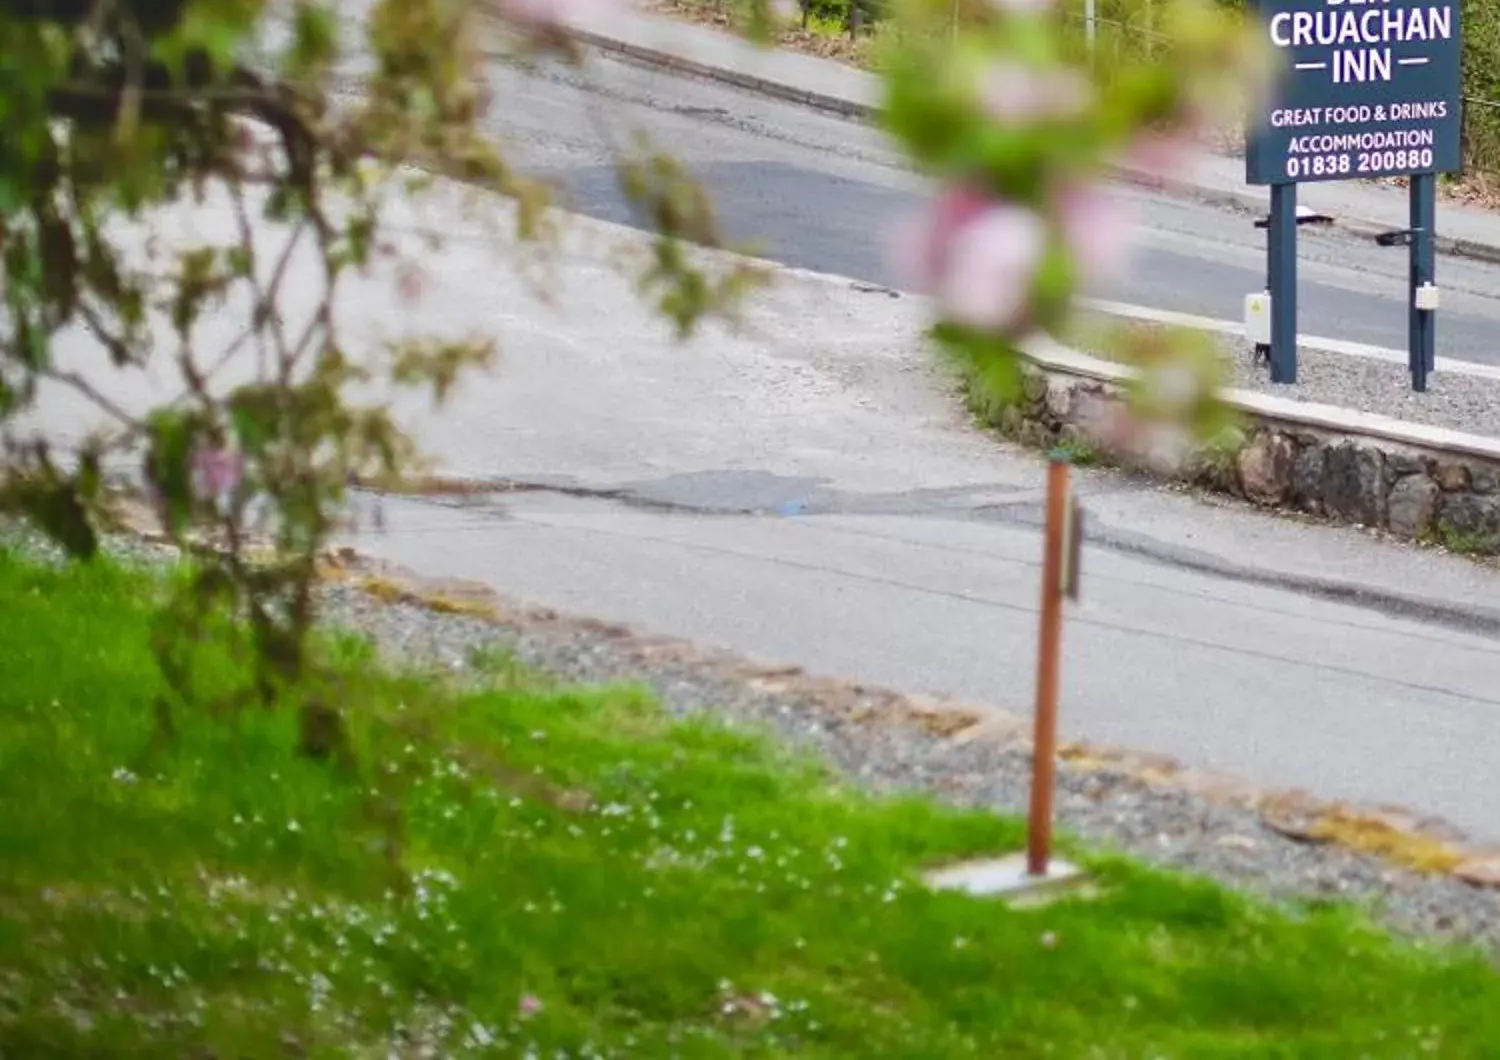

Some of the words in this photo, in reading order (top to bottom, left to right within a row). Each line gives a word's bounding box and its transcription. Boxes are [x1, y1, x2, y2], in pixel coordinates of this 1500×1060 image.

[1270, 5, 1451, 46] CRUACHAN
[1332, 47, 1392, 83] INN
[1271, 108, 1320, 127] GREAT
[1325, 105, 1371, 123] FOOD
[1374, 105, 1387, 121] &
[1391, 101, 1447, 119] DRINKS
[1288, 129, 1434, 154] ACCOMMODATION
[1287, 155, 1351, 177] 01838
[1357, 148, 1434, 171] 200880
